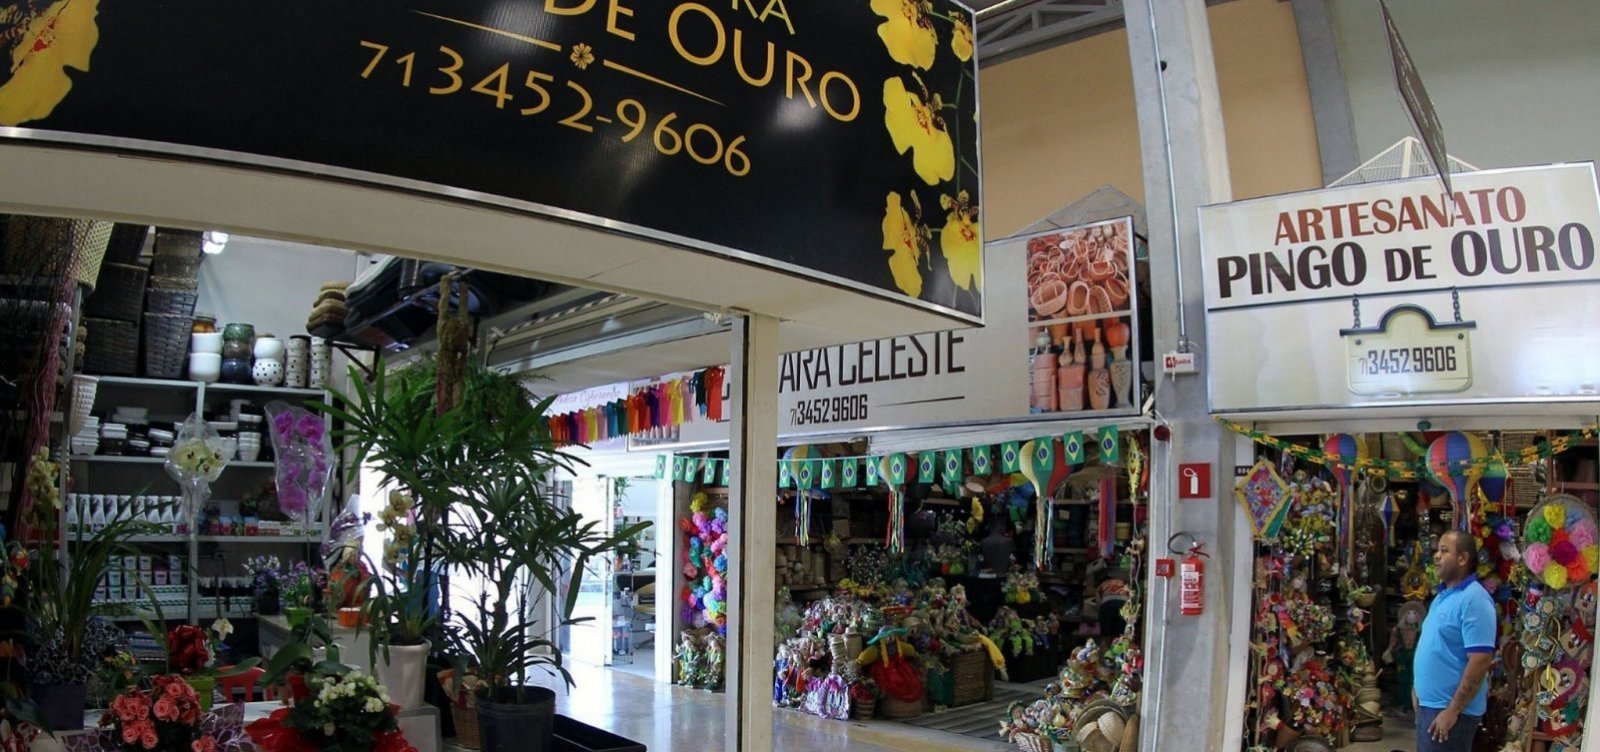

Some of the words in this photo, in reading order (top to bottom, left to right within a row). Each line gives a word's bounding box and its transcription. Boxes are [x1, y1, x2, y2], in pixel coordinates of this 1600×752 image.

[544, 0, 635, 41] E
[668, 2, 861, 122] OURO
[360, 40, 414, 86] 71
[429, 46, 751, 177] 3452-9606
[1274, 186, 1526, 246] ARTESANATO
[1217, 241, 1367, 298] PINGO
[1385, 245, 1437, 283] DE
[1451, 222, 1595, 277] OURO
[838, 331, 965, 386] CELESTE
